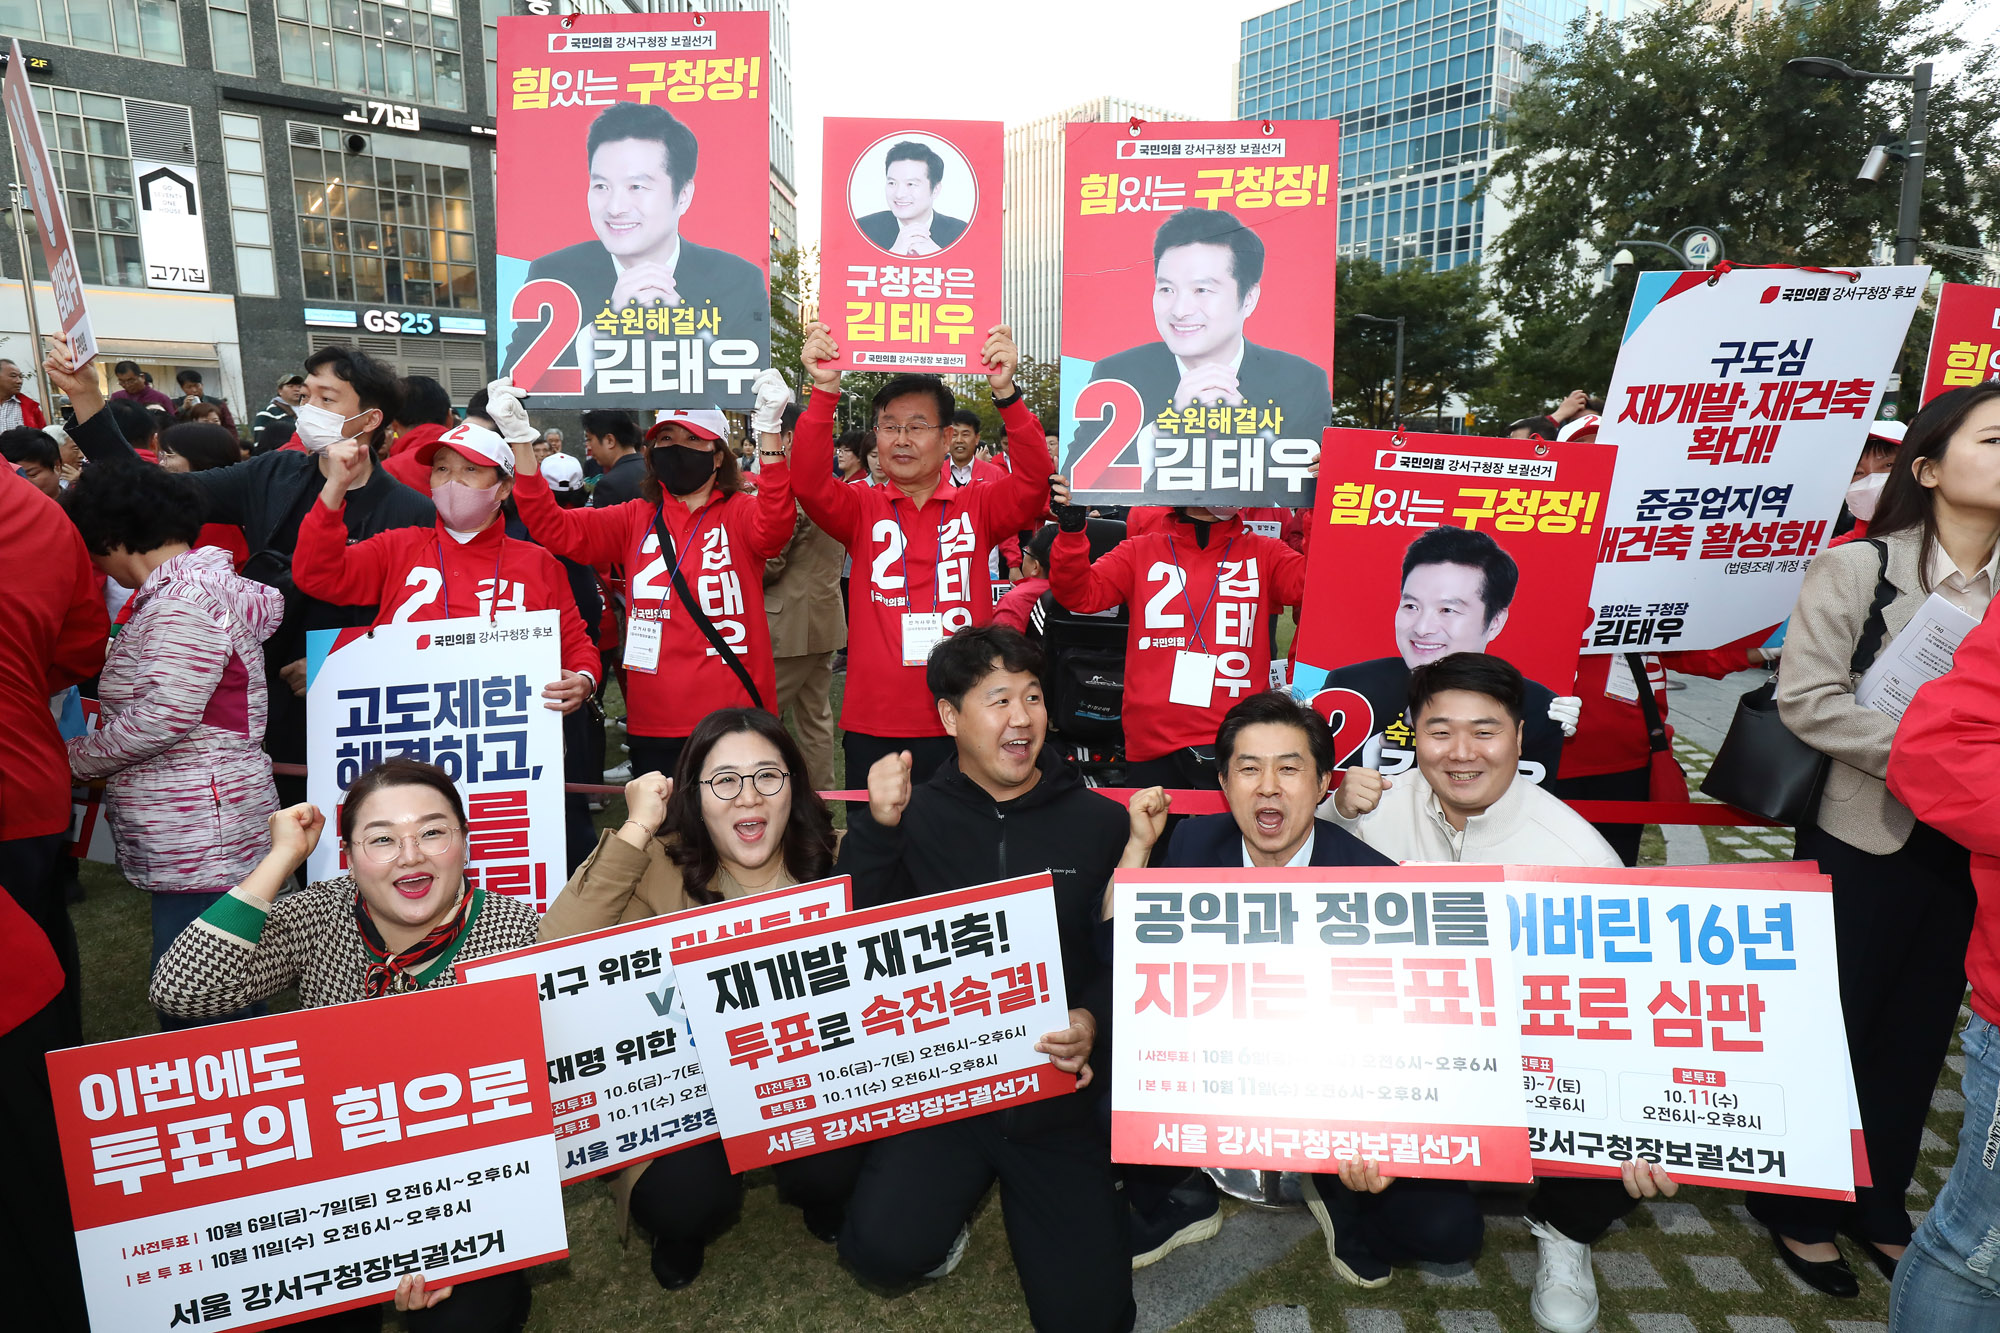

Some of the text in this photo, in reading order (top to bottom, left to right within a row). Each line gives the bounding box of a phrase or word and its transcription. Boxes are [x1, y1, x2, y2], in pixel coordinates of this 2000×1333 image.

[571, 34, 713, 49] 국민의힘 강서구청장 보궐선거
[31, 58, 48, 68] 2F
[512, 56, 761, 110] 힘있는 구청장!
[342, 97, 420, 131] 고기집
[1139, 142, 1282, 155] 국민의힘 강서구청장 보궐선거
[1080, 164, 1330, 215] 힘있는 구청장!
[150, 265, 205, 283] 고기집
[846, 266, 975, 299] 구청장은
[1782, 285, 1917, 302] 국민의힘 강서구청장 후보
[363, 310, 433, 335] GS25
[510, 279, 722, 397] 2 숙원해결사
[845, 301, 975, 343] 김태우
[594, 340, 760, 396] 김태우
[868, 354, 964, 366] 국민의힘 강서구청장 보궐선거
[1710, 338, 1814, 377] 구도심
[449, 425, 471, 441] 2
[1070, 378, 1284, 493] 2 숙원해결사
[1687, 425, 1781, 465] 확대!
[1154, 437, 1319, 493] 김태우
[1399, 456, 1553, 478] 국민의힘 강서구청장 보궐선거
[1329, 483, 1600, 534] 힘있는 구청장!
[1636, 484, 1793, 522] 준공업지역
[872, 519, 907, 590] 2
[1699, 520, 1828, 559] 활성화!
[633, 534, 676, 600] 2
[1775, 559, 1800, 573] 개정
[391, 566, 442, 625] 2
[698, 522, 748, 664] 김태우
[1145, 561, 1187, 629] 2
[1599, 603, 1642, 617] 힘있는
[1645, 602, 1689, 617] 구청장
[434, 626, 553, 647] 국민의힘 강서구청장 후보
[1152, 636, 1186, 648] 국민의힘
[1215, 557, 1260, 698] 김태우
[1593, 616, 1684, 647] 김태우
[1934, 625, 1944, 634] FAQ
[336, 674, 532, 737] 고도제한
[1134, 891, 1489, 946] 공익과 정의를
[1666, 903, 1796, 971] 16년
[598, 948, 662, 986] 위한
[707, 941, 851, 1014] 재개발
[857, 911, 1010, 981] 재건축!
[1134, 957, 1497, 1027] 지키는 투표!
[725, 1011, 855, 1071] 투표로
[861, 961, 1050, 1037] 속전속결!
[1647, 980, 1766, 1053] 심판
[616, 1027, 676, 1065] 위한
[759, 1025, 1027, 1097] 사전투표 10.6(금)~7(토) 오전6시~오후6시
[1145, 1050, 1189, 1063] 사전투표
[1202, 1050, 1233, 1064] 10월
[79, 1040, 304, 1121] 이번에도
[770, 1053, 998, 1116] 본투표 10.11(수) 오전6시~오후8시
[1202, 1080, 1233, 1095] 10월
[1681, 1071, 1717, 1084] 본투표
[552, 1098, 594, 1115] 전투표
[607, 1093, 675, 1122] 10.11(수)
[766, 1074, 1040, 1156] 서울 강서구청장보궐선거
[1642, 1106, 1761, 1130] 오전6시~오후8시
[1664, 1089, 1739, 1110] 10.11(수)
[90, 1058, 533, 1196] 투표의 힘으로
[1153, 1124, 1481, 1168] 서울 강서구청장보궐선거
[565, 1141, 609, 1169] 서울
[131, 1160, 531, 1258] 사전투표 10월 6일(금)~7일(토) 오전6시~오후6시
[211, 1248, 247, 1270] 10월
[252, 1232, 315, 1262] 11일(수)
[323, 1198, 472, 1244] 오전6시~오후8시
[170, 1229, 506, 1329] 서울 강서구청장보궐선거
